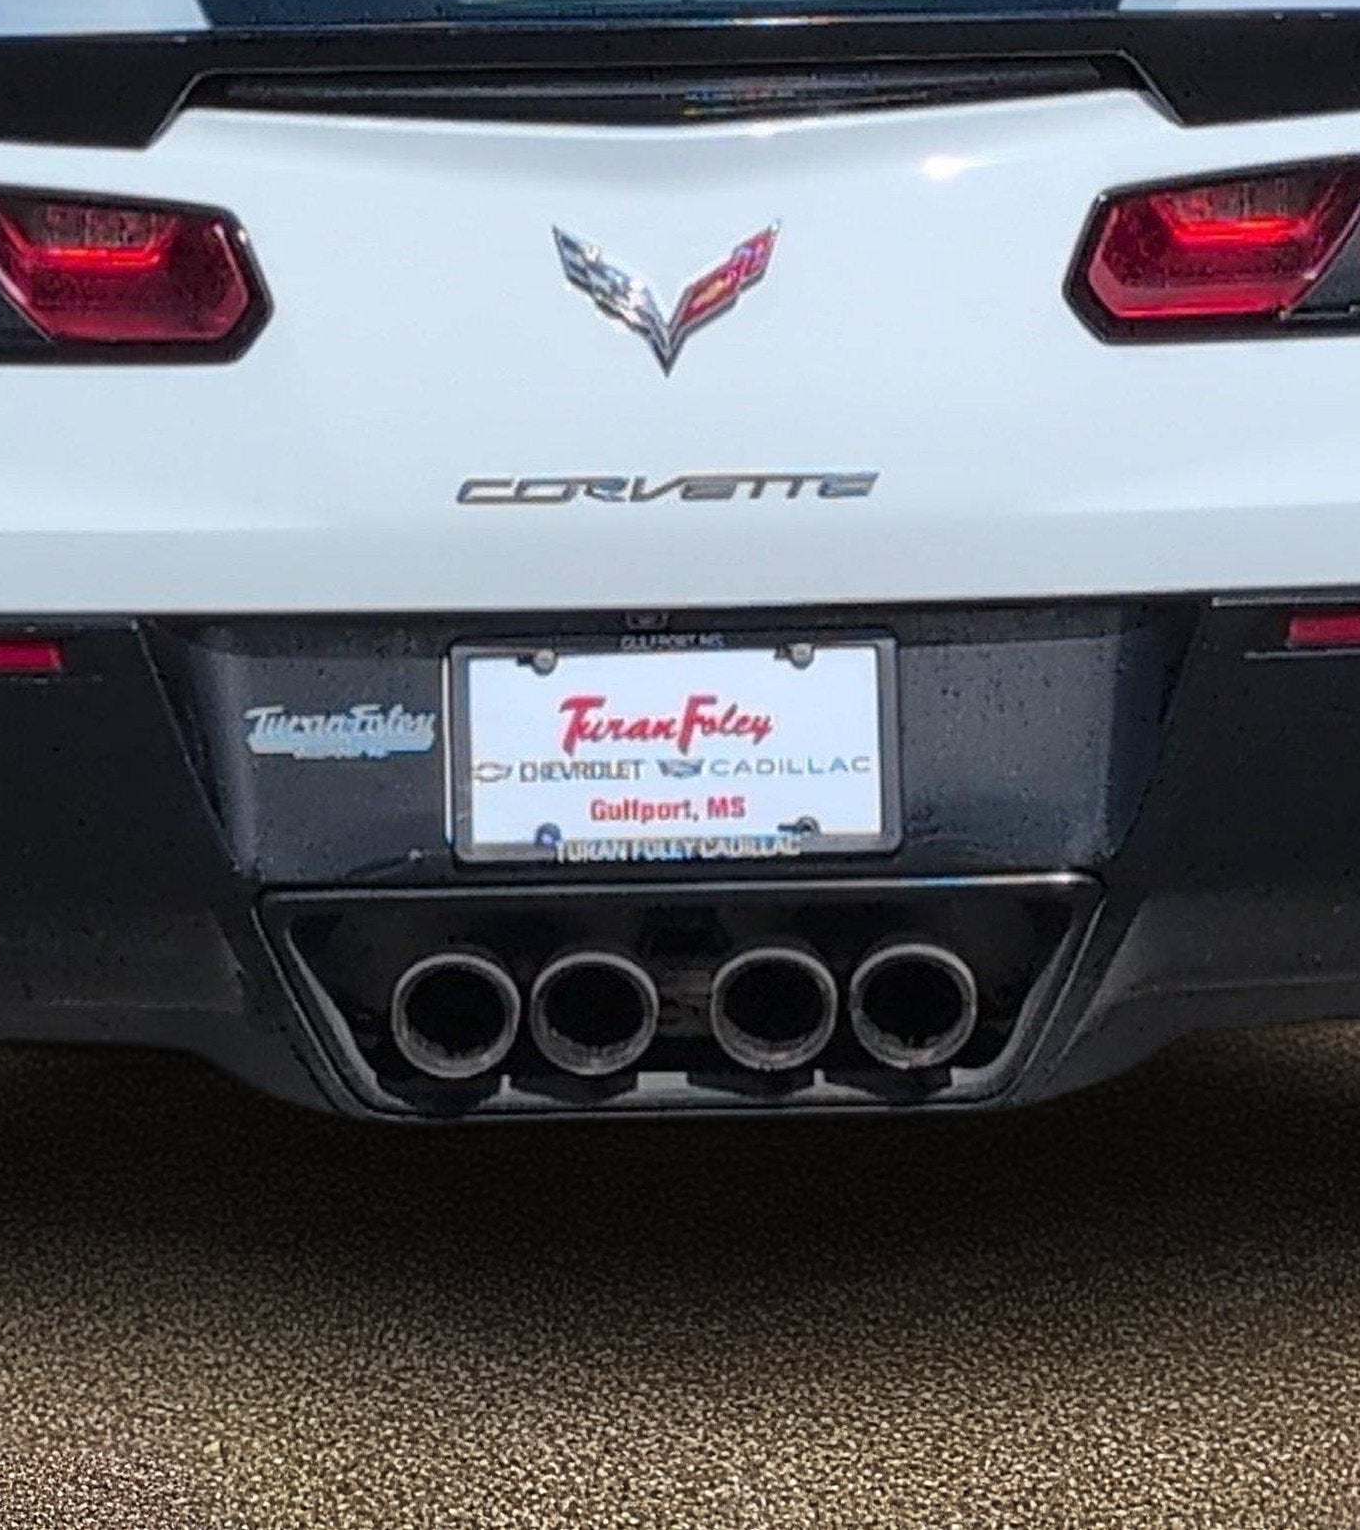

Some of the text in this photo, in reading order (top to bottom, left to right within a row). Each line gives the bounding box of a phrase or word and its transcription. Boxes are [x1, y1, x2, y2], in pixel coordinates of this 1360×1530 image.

[456, 472, 880, 504] CORVETTE
[520, 756, 870, 782] CHEVROLET CADILLAC
[590, 797, 747, 823] Gulfport, MS
